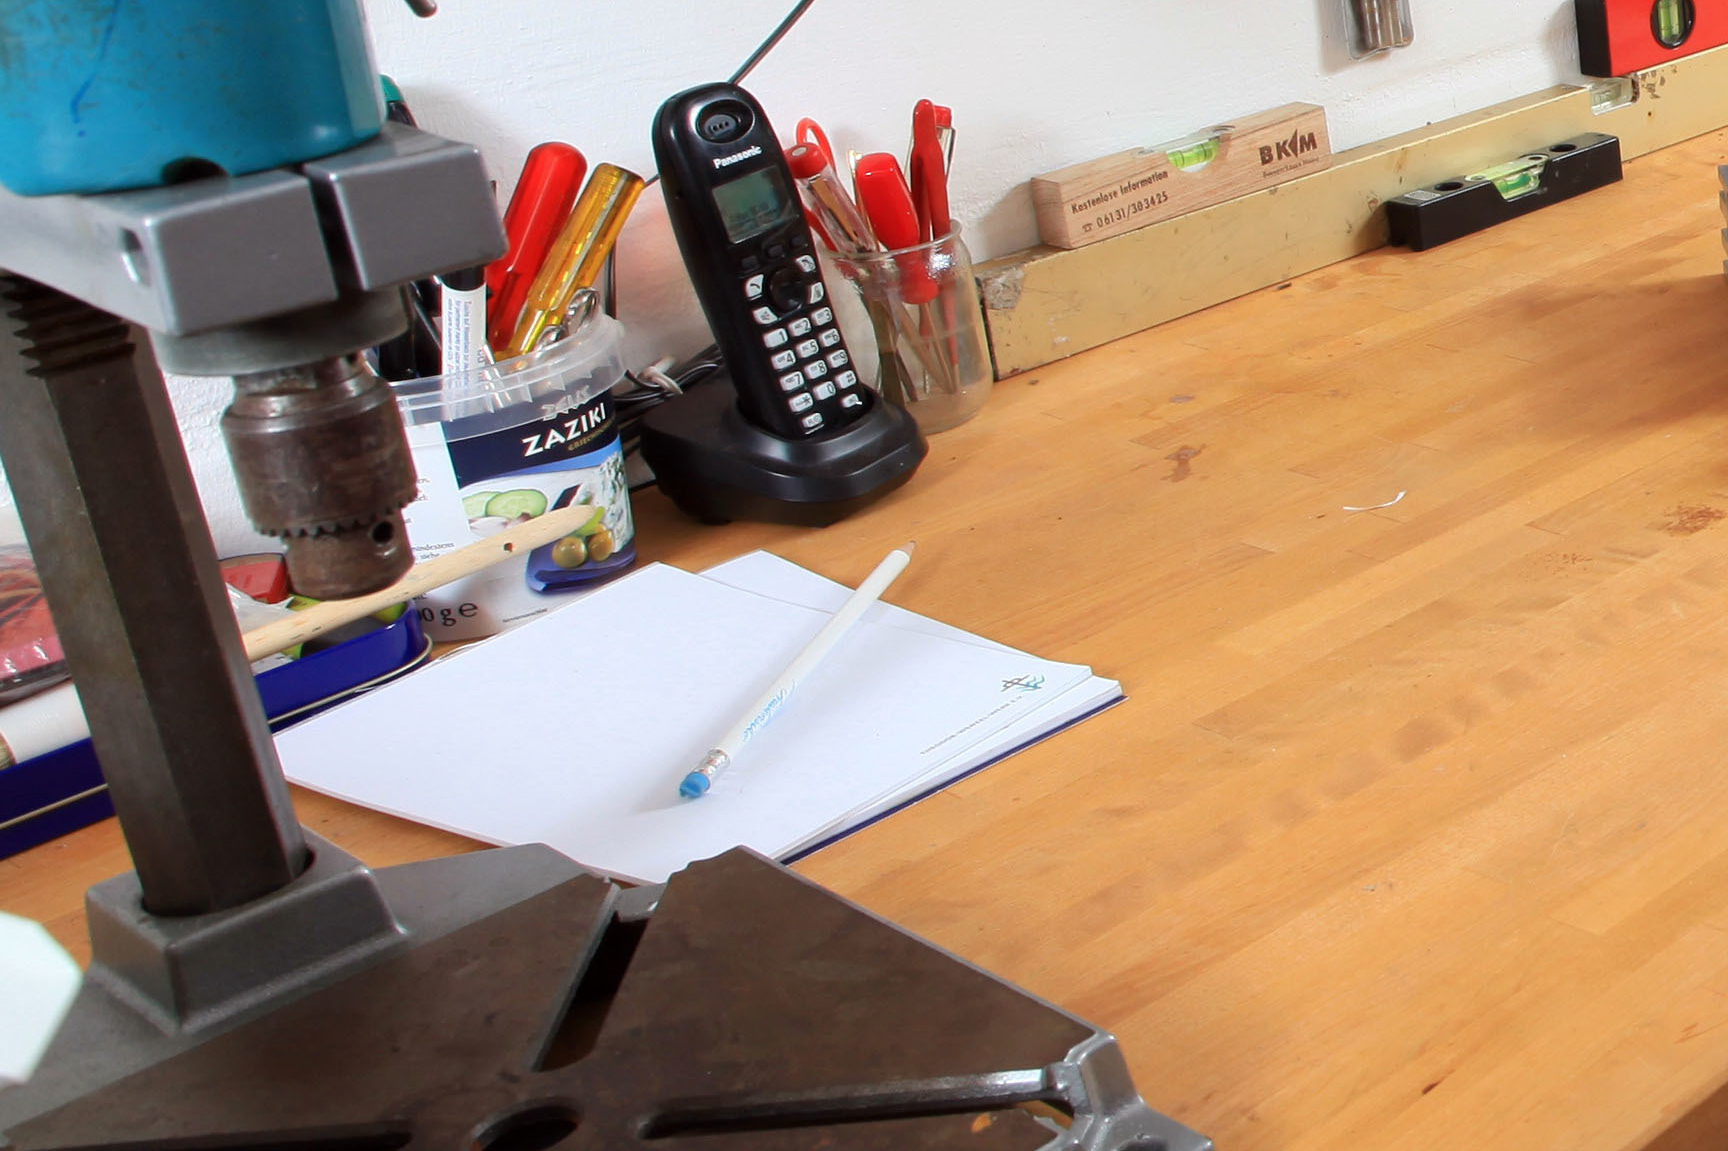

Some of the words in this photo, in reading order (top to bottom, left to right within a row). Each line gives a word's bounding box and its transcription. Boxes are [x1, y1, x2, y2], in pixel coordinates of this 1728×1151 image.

[713, 144, 763, 171] Panasonic
[1071, 189, 1118, 215] Kostenlose
[1119, 169, 1169, 197] Information
[1096, 191, 1169, 229] 06131/303425
[778, 331, 786, 343] 1
[802, 319, 810, 332] 2
[825, 309, 832, 321] 3
[786, 352, 794, 364] 4
[809, 341, 818, 353] 5
[832, 330, 840, 342] 6
[795, 374, 802, 386] 7
[818, 361, 827, 374] 8
[827, 384, 835, 396] 0
[521, 402, 606, 458] ZAZIKI
[440, 608, 456, 627] g
